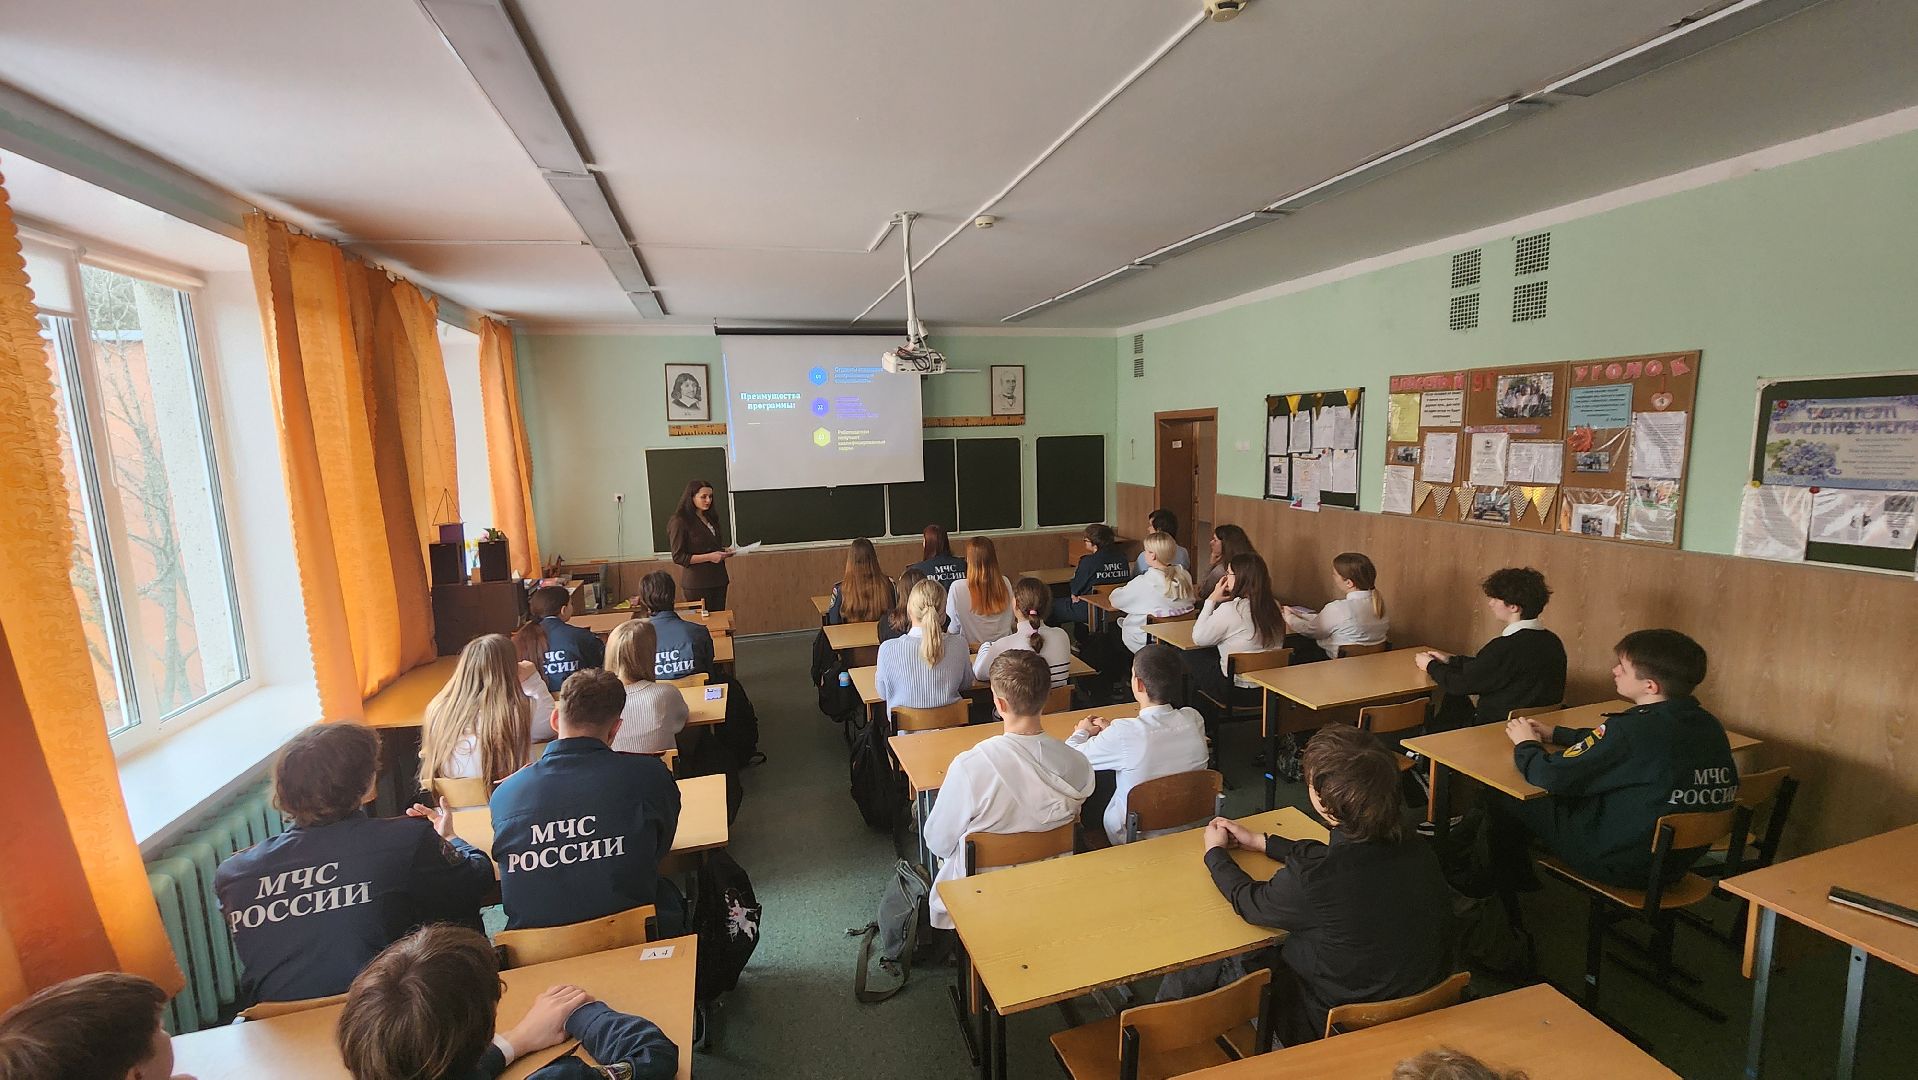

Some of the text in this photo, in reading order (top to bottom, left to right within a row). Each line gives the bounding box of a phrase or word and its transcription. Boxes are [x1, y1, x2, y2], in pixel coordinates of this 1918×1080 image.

[1574, 356, 1691, 381] УГОЛОК
[740, 392, 801, 401] Преимущества
[934, 564, 957, 573] МЧС
[1096, 570, 1129, 579] РОССИИ
[1103, 562, 1123, 571] МЧС
[544, 650, 566, 662] ЧС
[543, 660, 579, 674] СИИ
[655, 659, 695, 675] ССИИ
[1693, 766, 1730, 785] МЧС
[530, 815, 596, 845] МЧС
[507, 835, 625, 873] РОССИИ
[254, 862, 339, 900] МЧС
[229, 881, 373, 934] РОССИИ
